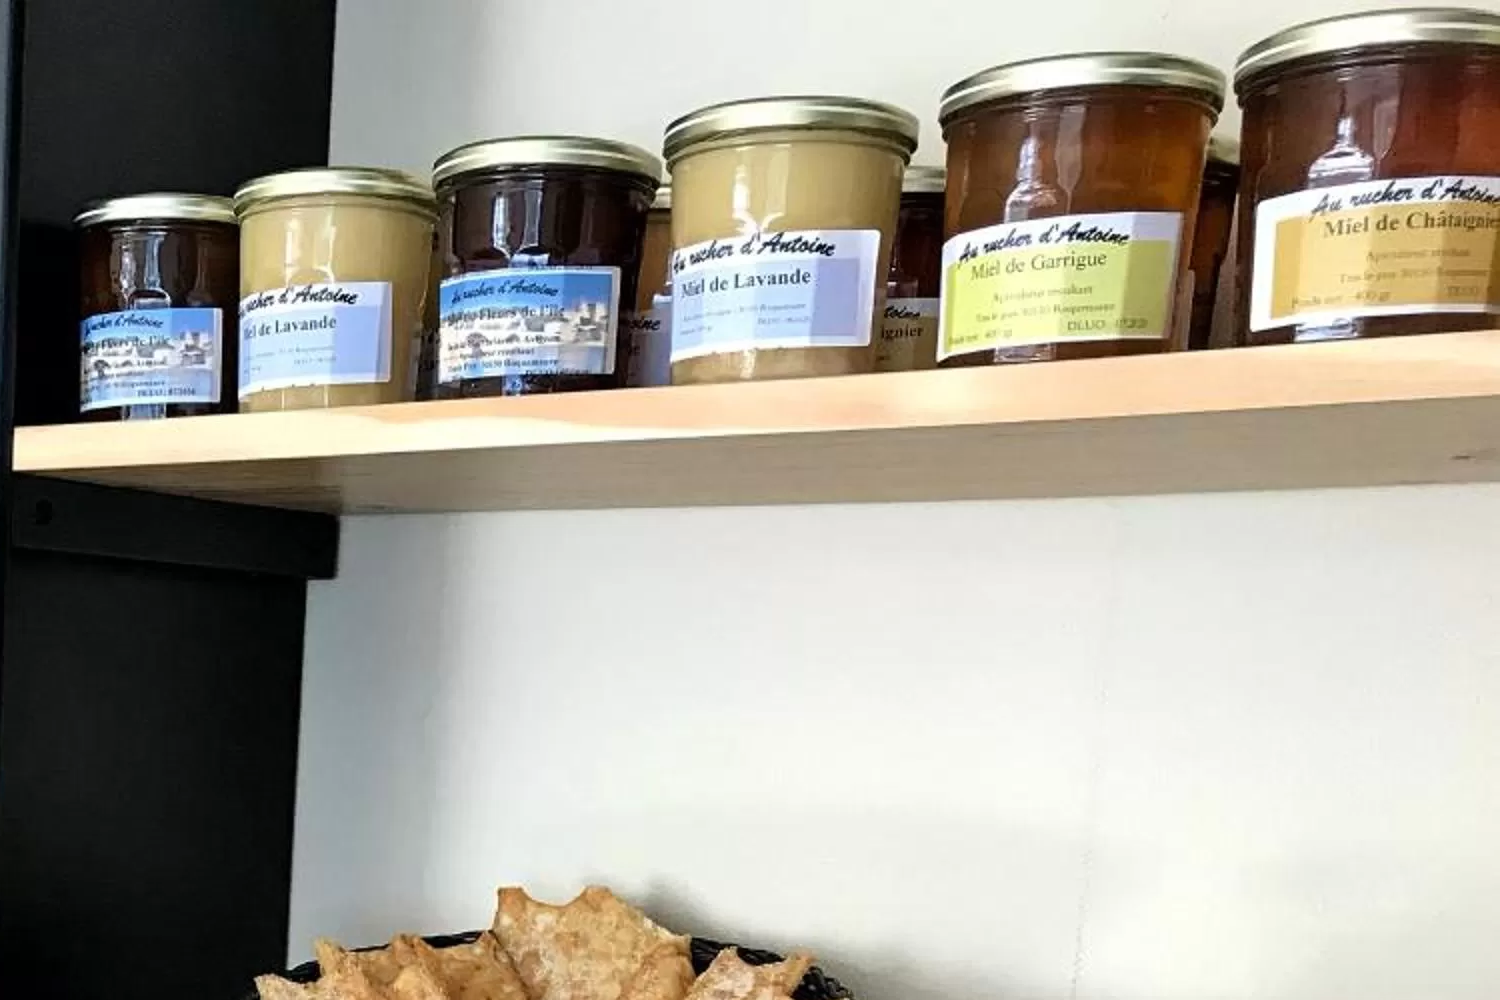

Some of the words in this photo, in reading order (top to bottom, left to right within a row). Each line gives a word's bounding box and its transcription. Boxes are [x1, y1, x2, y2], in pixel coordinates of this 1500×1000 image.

[1309, 193, 1342, 222] Au
[1350, 180, 1413, 208] rucher
[1324, 216, 1369, 238] Miel
[1375, 214, 1400, 232] de
[1406, 210, 1500, 232] Châtaignie
[740, 231, 836, 257] d'Antoine
[956, 241, 978, 270] Au
[983, 229, 1032, 255] rucher
[1039, 221, 1130, 247] d'Antoine
[970, 260, 1000, 281] Miel
[1005, 258, 1026, 274] de
[1031, 251, 1107, 272] Garrigue
[709, 275, 729, 292] de
[734, 268, 812, 289] Lavande
[278, 283, 359, 305] d'Antoine
[275, 315, 337, 334] Lavande
